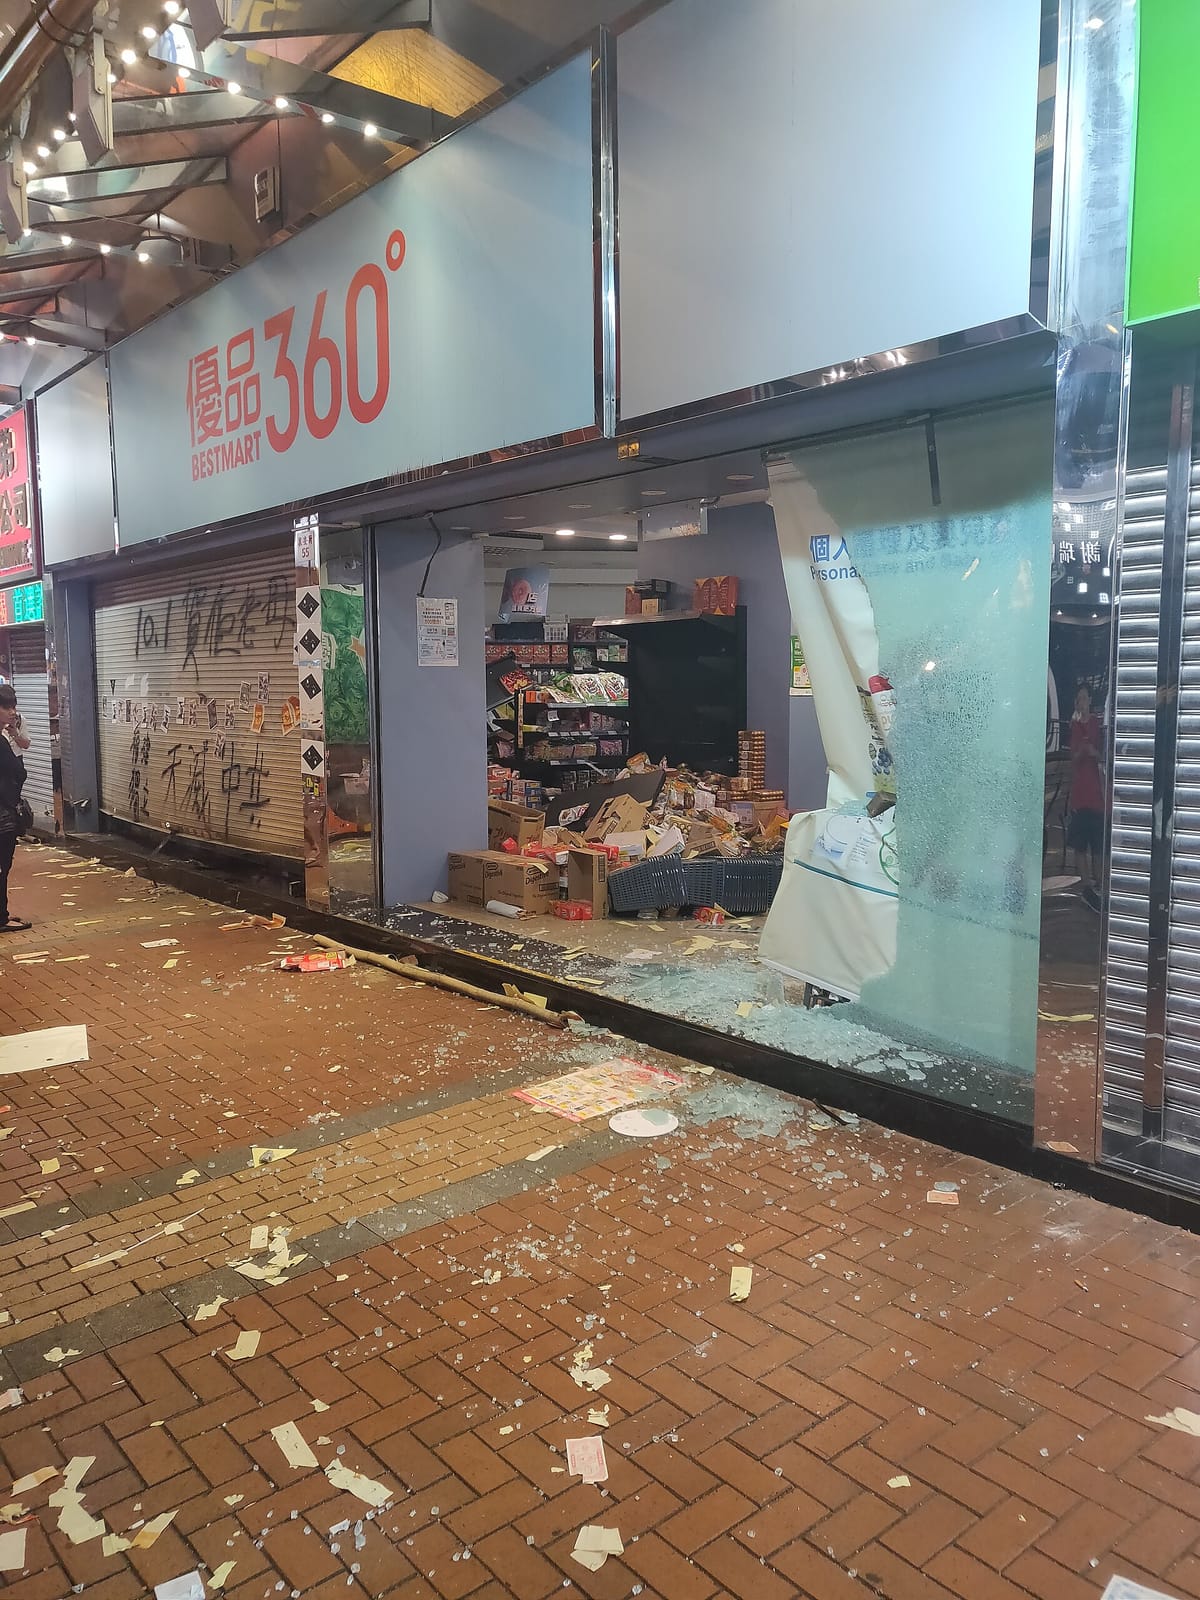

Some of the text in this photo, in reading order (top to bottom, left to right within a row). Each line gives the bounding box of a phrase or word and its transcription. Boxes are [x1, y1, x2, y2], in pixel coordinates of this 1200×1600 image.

[186, 328, 262, 448] 優品
[192, 430, 262, 481] BESTMART
[301, 547, 310, 559] 55
[810, 565, 861, 581] Prsona
[135, 597, 173, 660] 10.1
